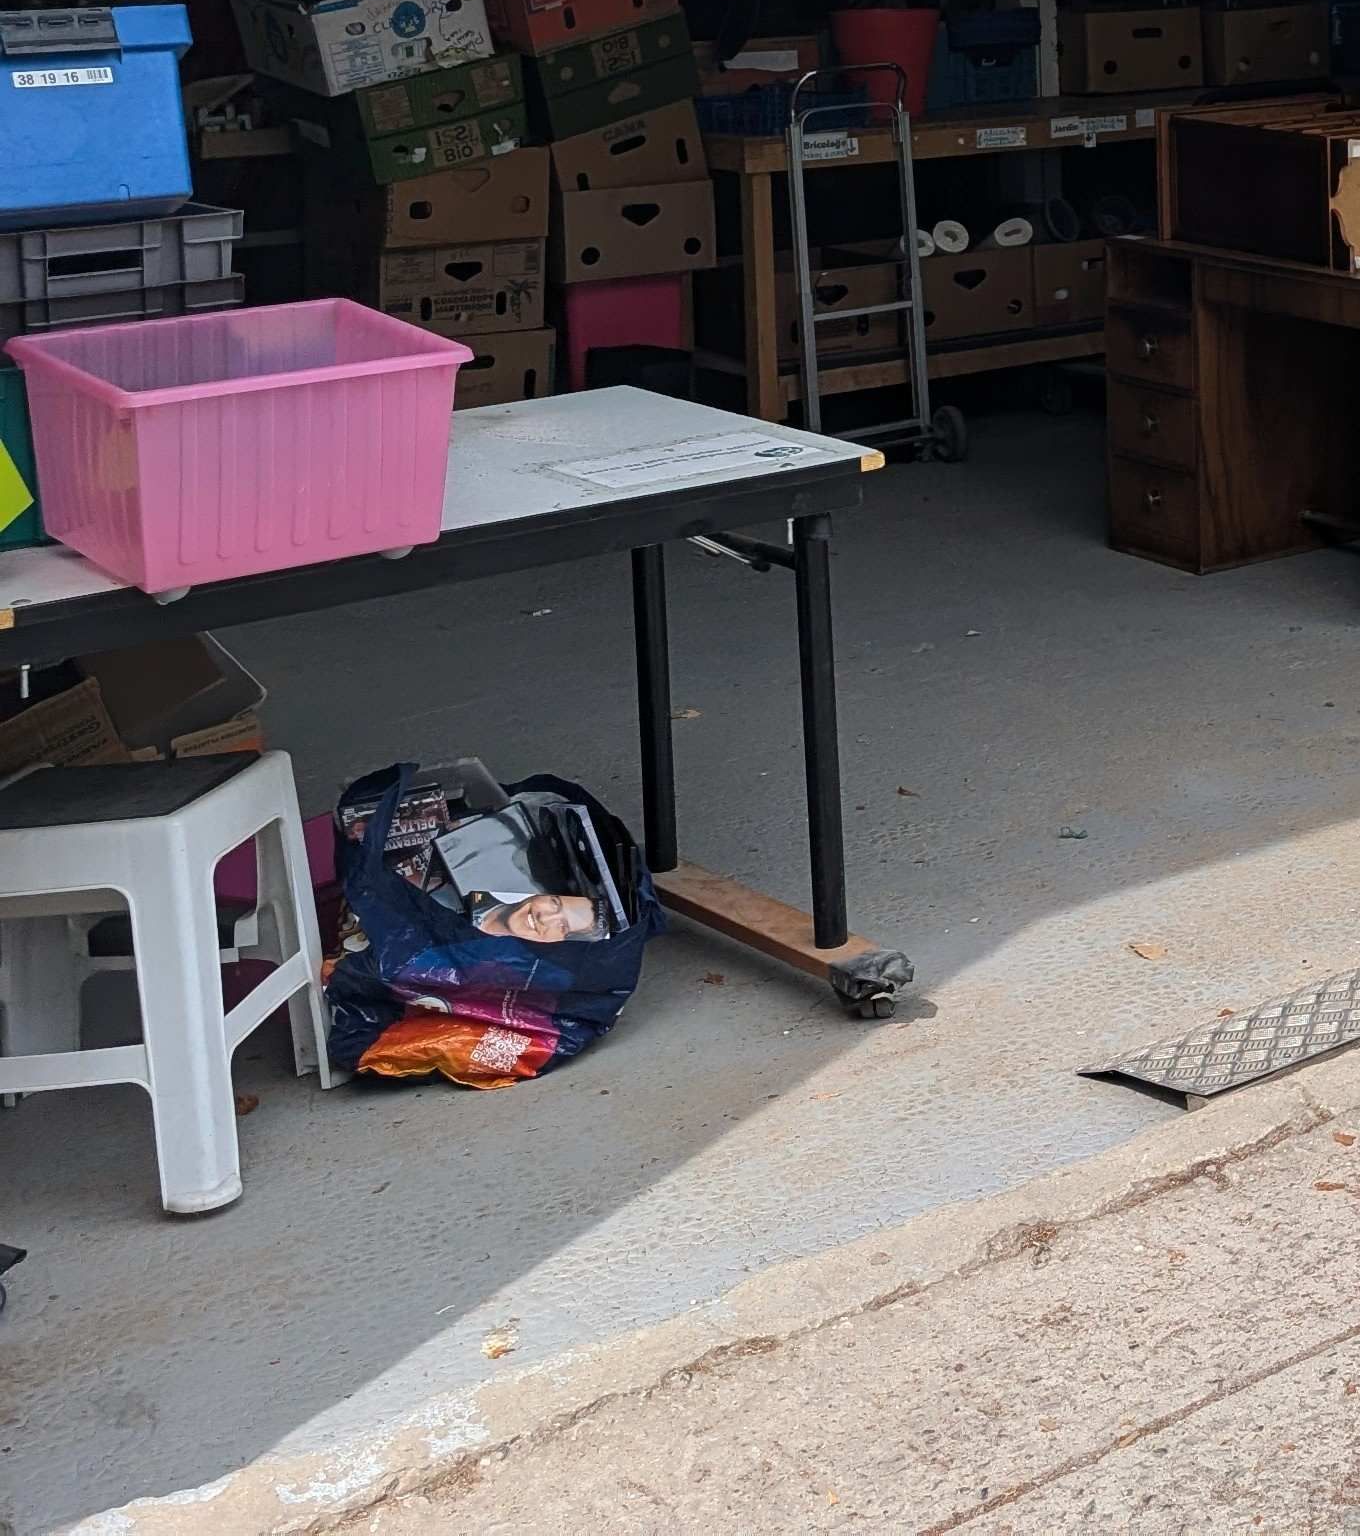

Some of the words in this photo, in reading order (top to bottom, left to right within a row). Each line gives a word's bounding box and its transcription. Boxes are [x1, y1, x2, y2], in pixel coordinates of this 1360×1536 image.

[17, 74, 35, 86] 38
[41, 73, 57, 85] 19
[64, 72, 79, 83] 16
[803, 138, 847, 150] Bricolage
[401, 818, 437, 834] DELTA
